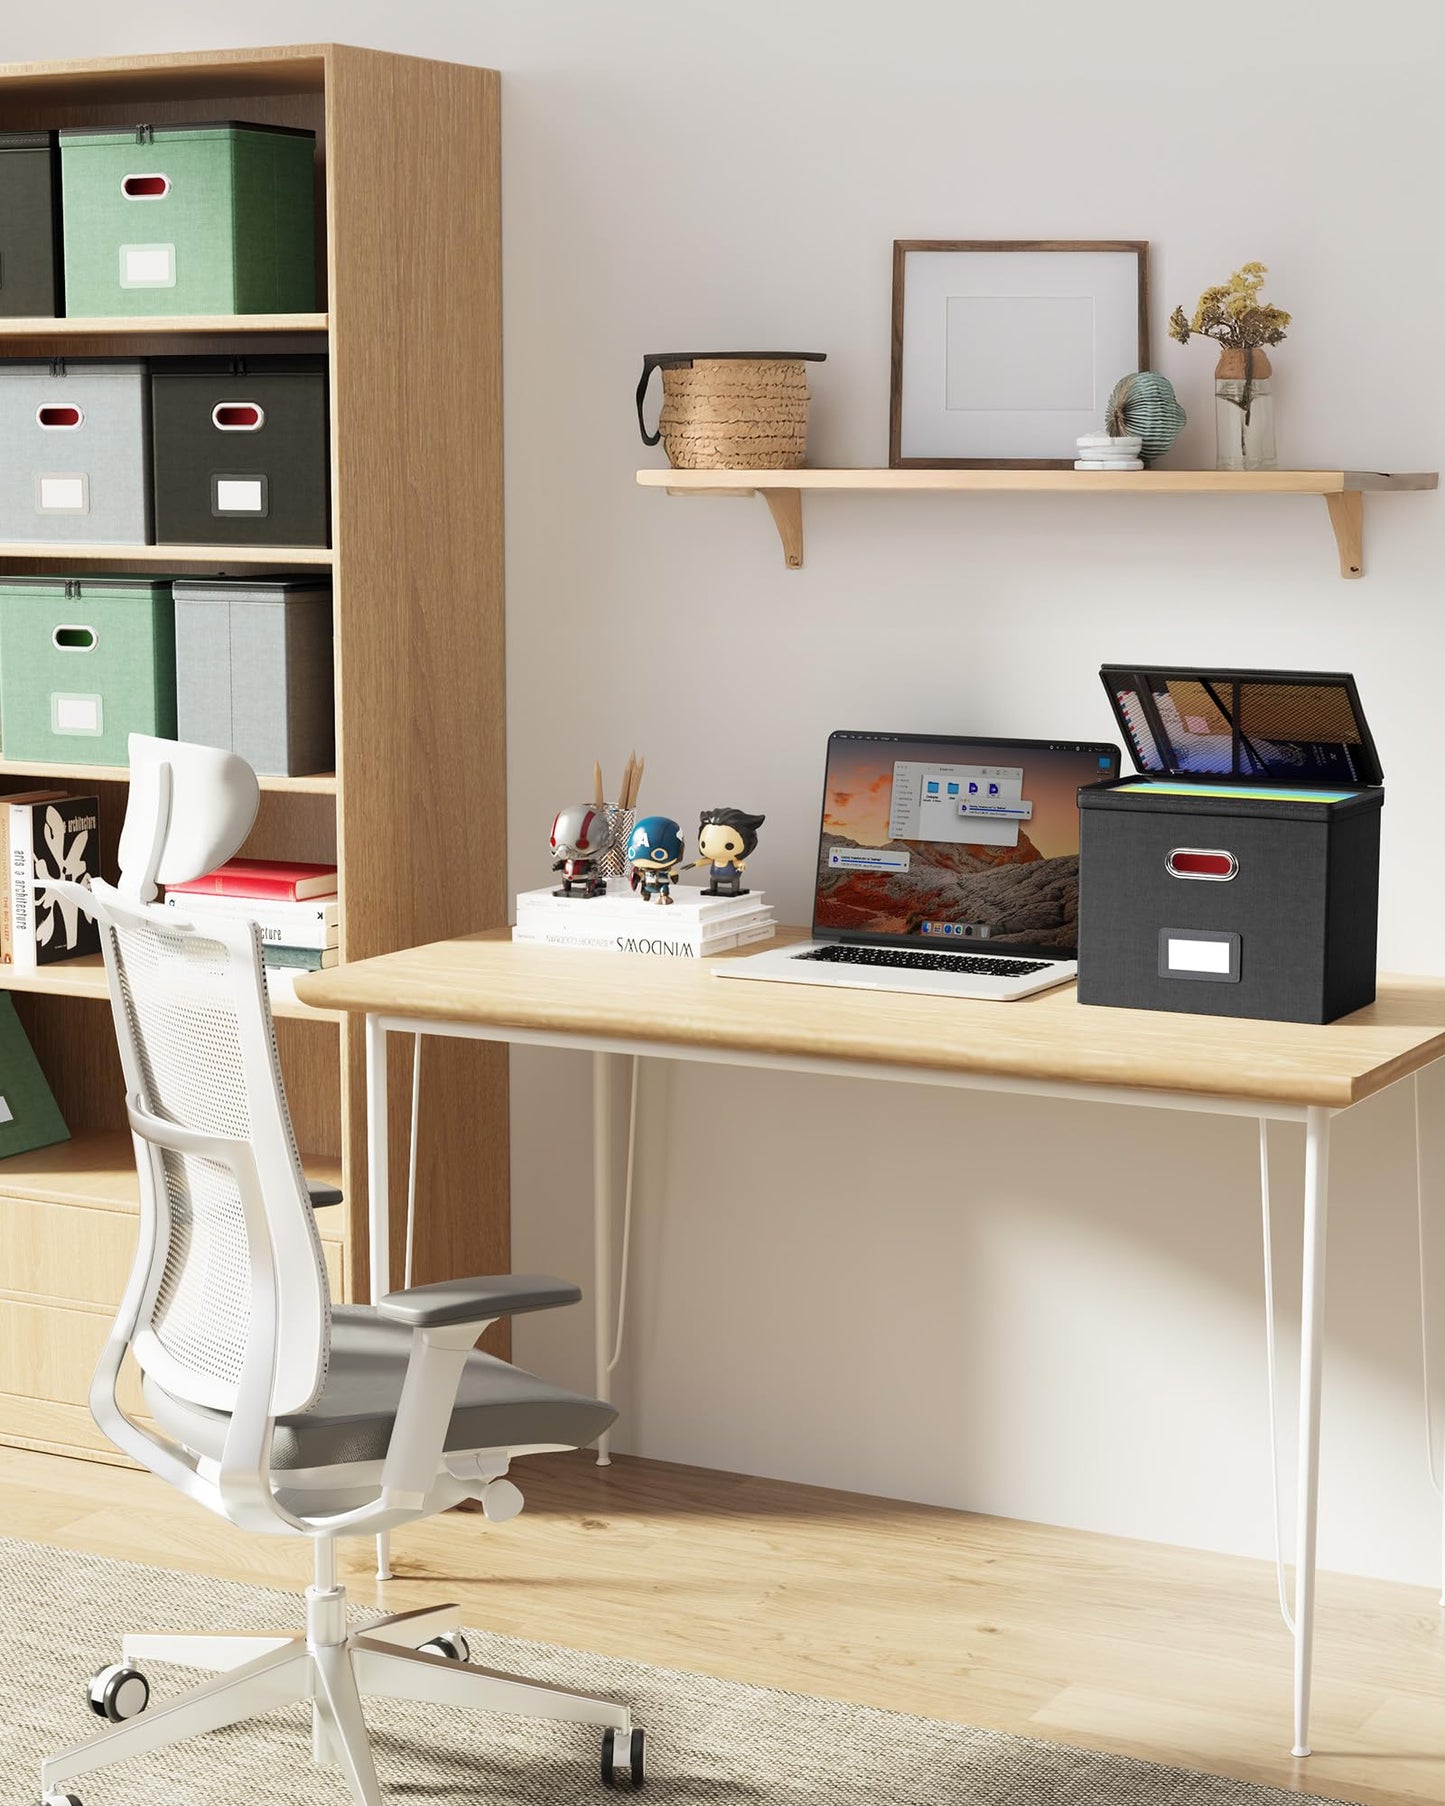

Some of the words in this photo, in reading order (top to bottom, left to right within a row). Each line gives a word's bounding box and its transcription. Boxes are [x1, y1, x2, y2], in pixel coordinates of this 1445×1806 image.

[68, 816, 96, 832] architecture
[632, 827, 650, 848] A
[14, 850, 25, 866] arts
[15, 879, 28, 930] architecture
[616, 936, 694, 958] WINDOWS
